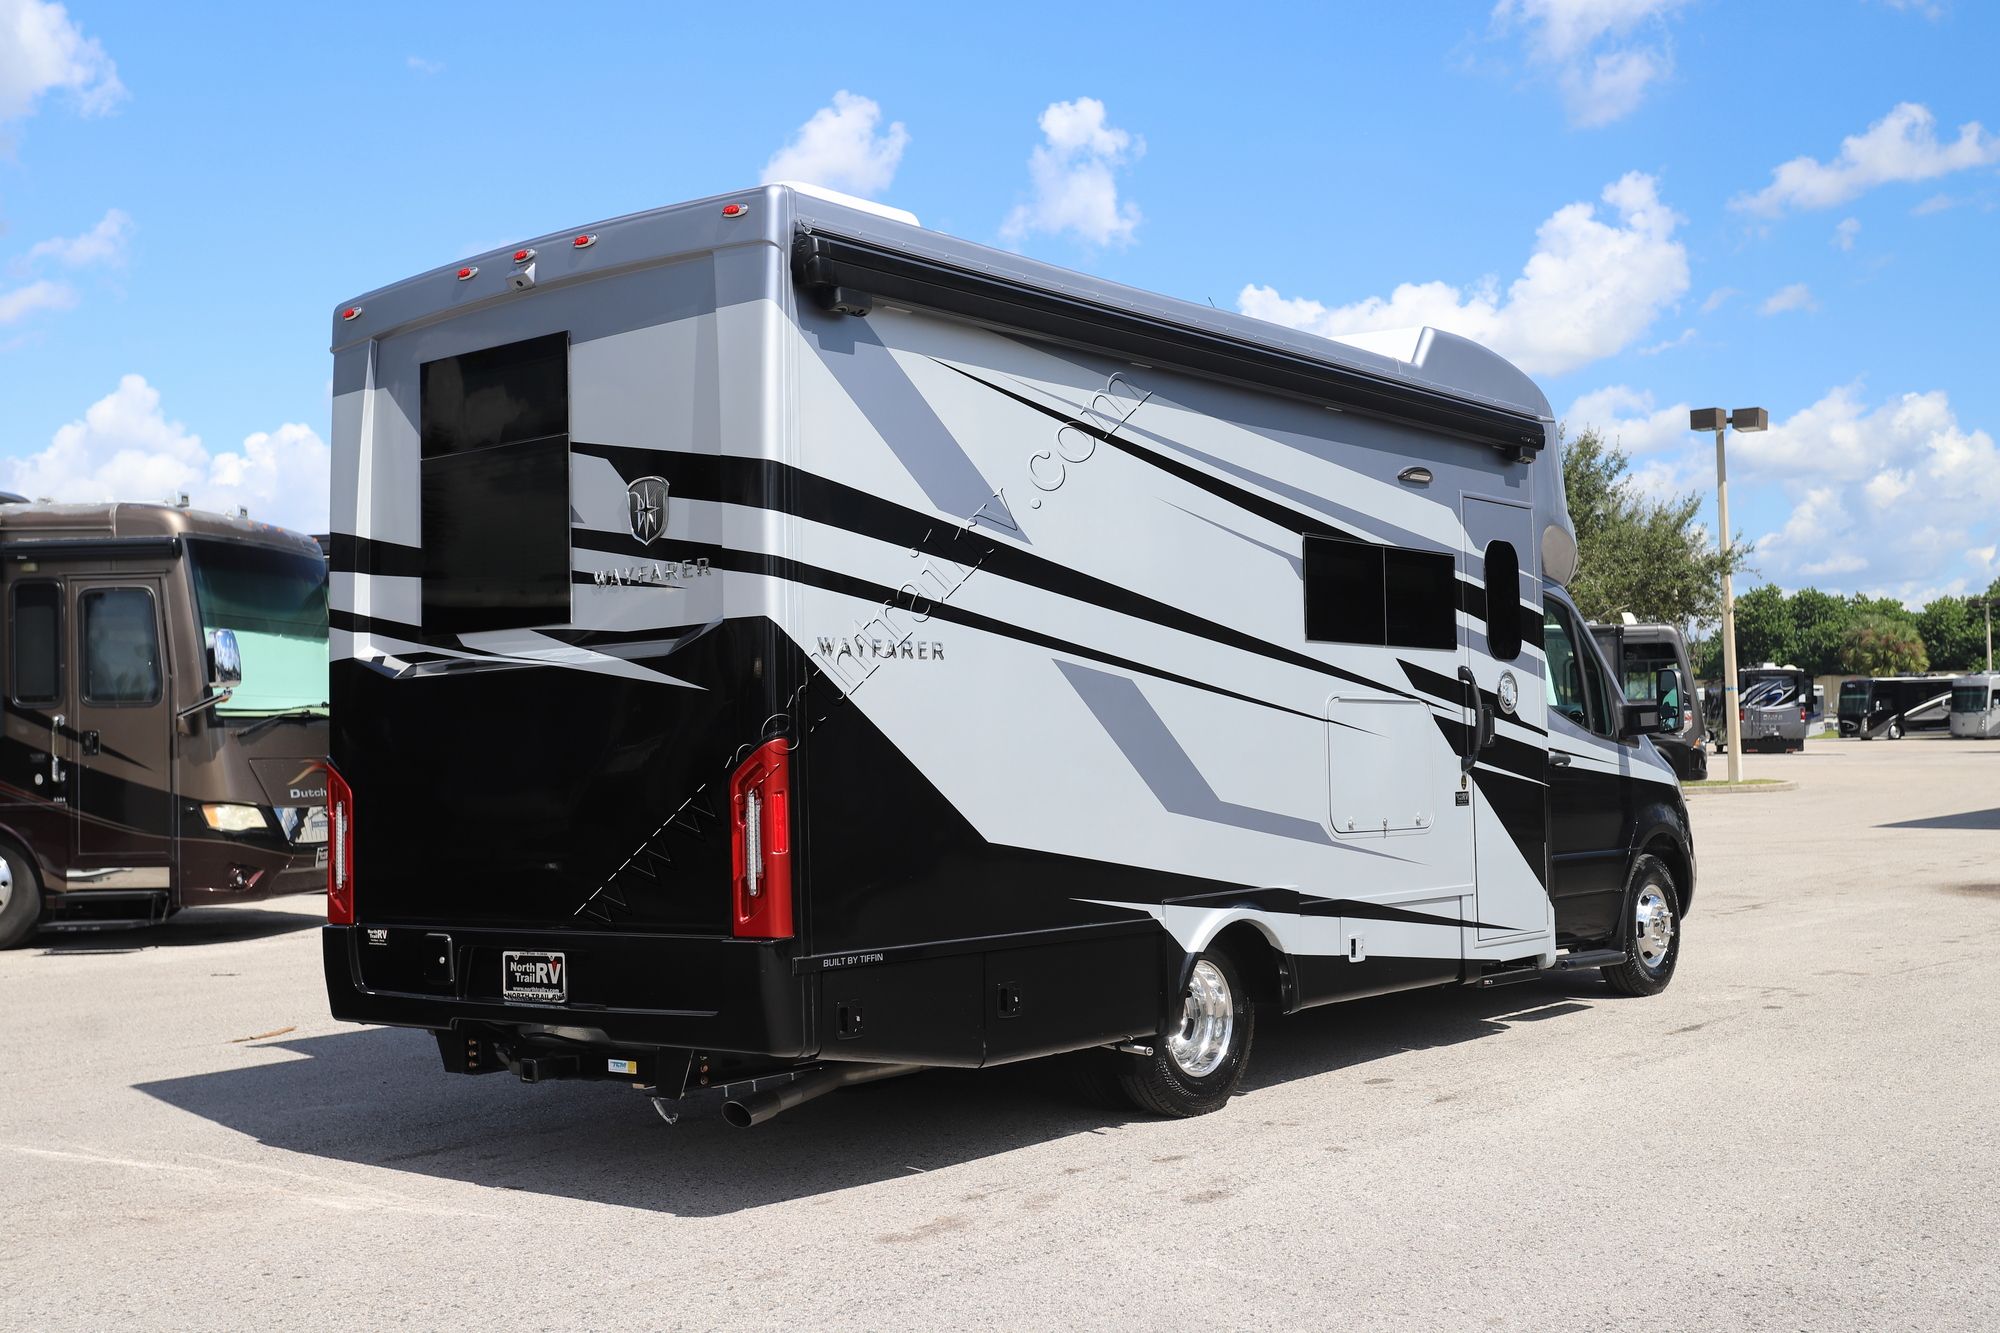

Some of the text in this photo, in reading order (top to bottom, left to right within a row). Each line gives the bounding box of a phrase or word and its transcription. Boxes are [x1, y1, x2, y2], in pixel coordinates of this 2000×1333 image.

[594, 558, 711, 588] WAYFARER
[817, 636, 945, 660] WAYFARER
[377, 929, 388, 939] RV
[510, 961, 535, 972] North
[823, 953, 884, 968] BUILT BY TIFFIN
[515, 972, 535, 983] Trail
[535, 962, 561, 984] RV
